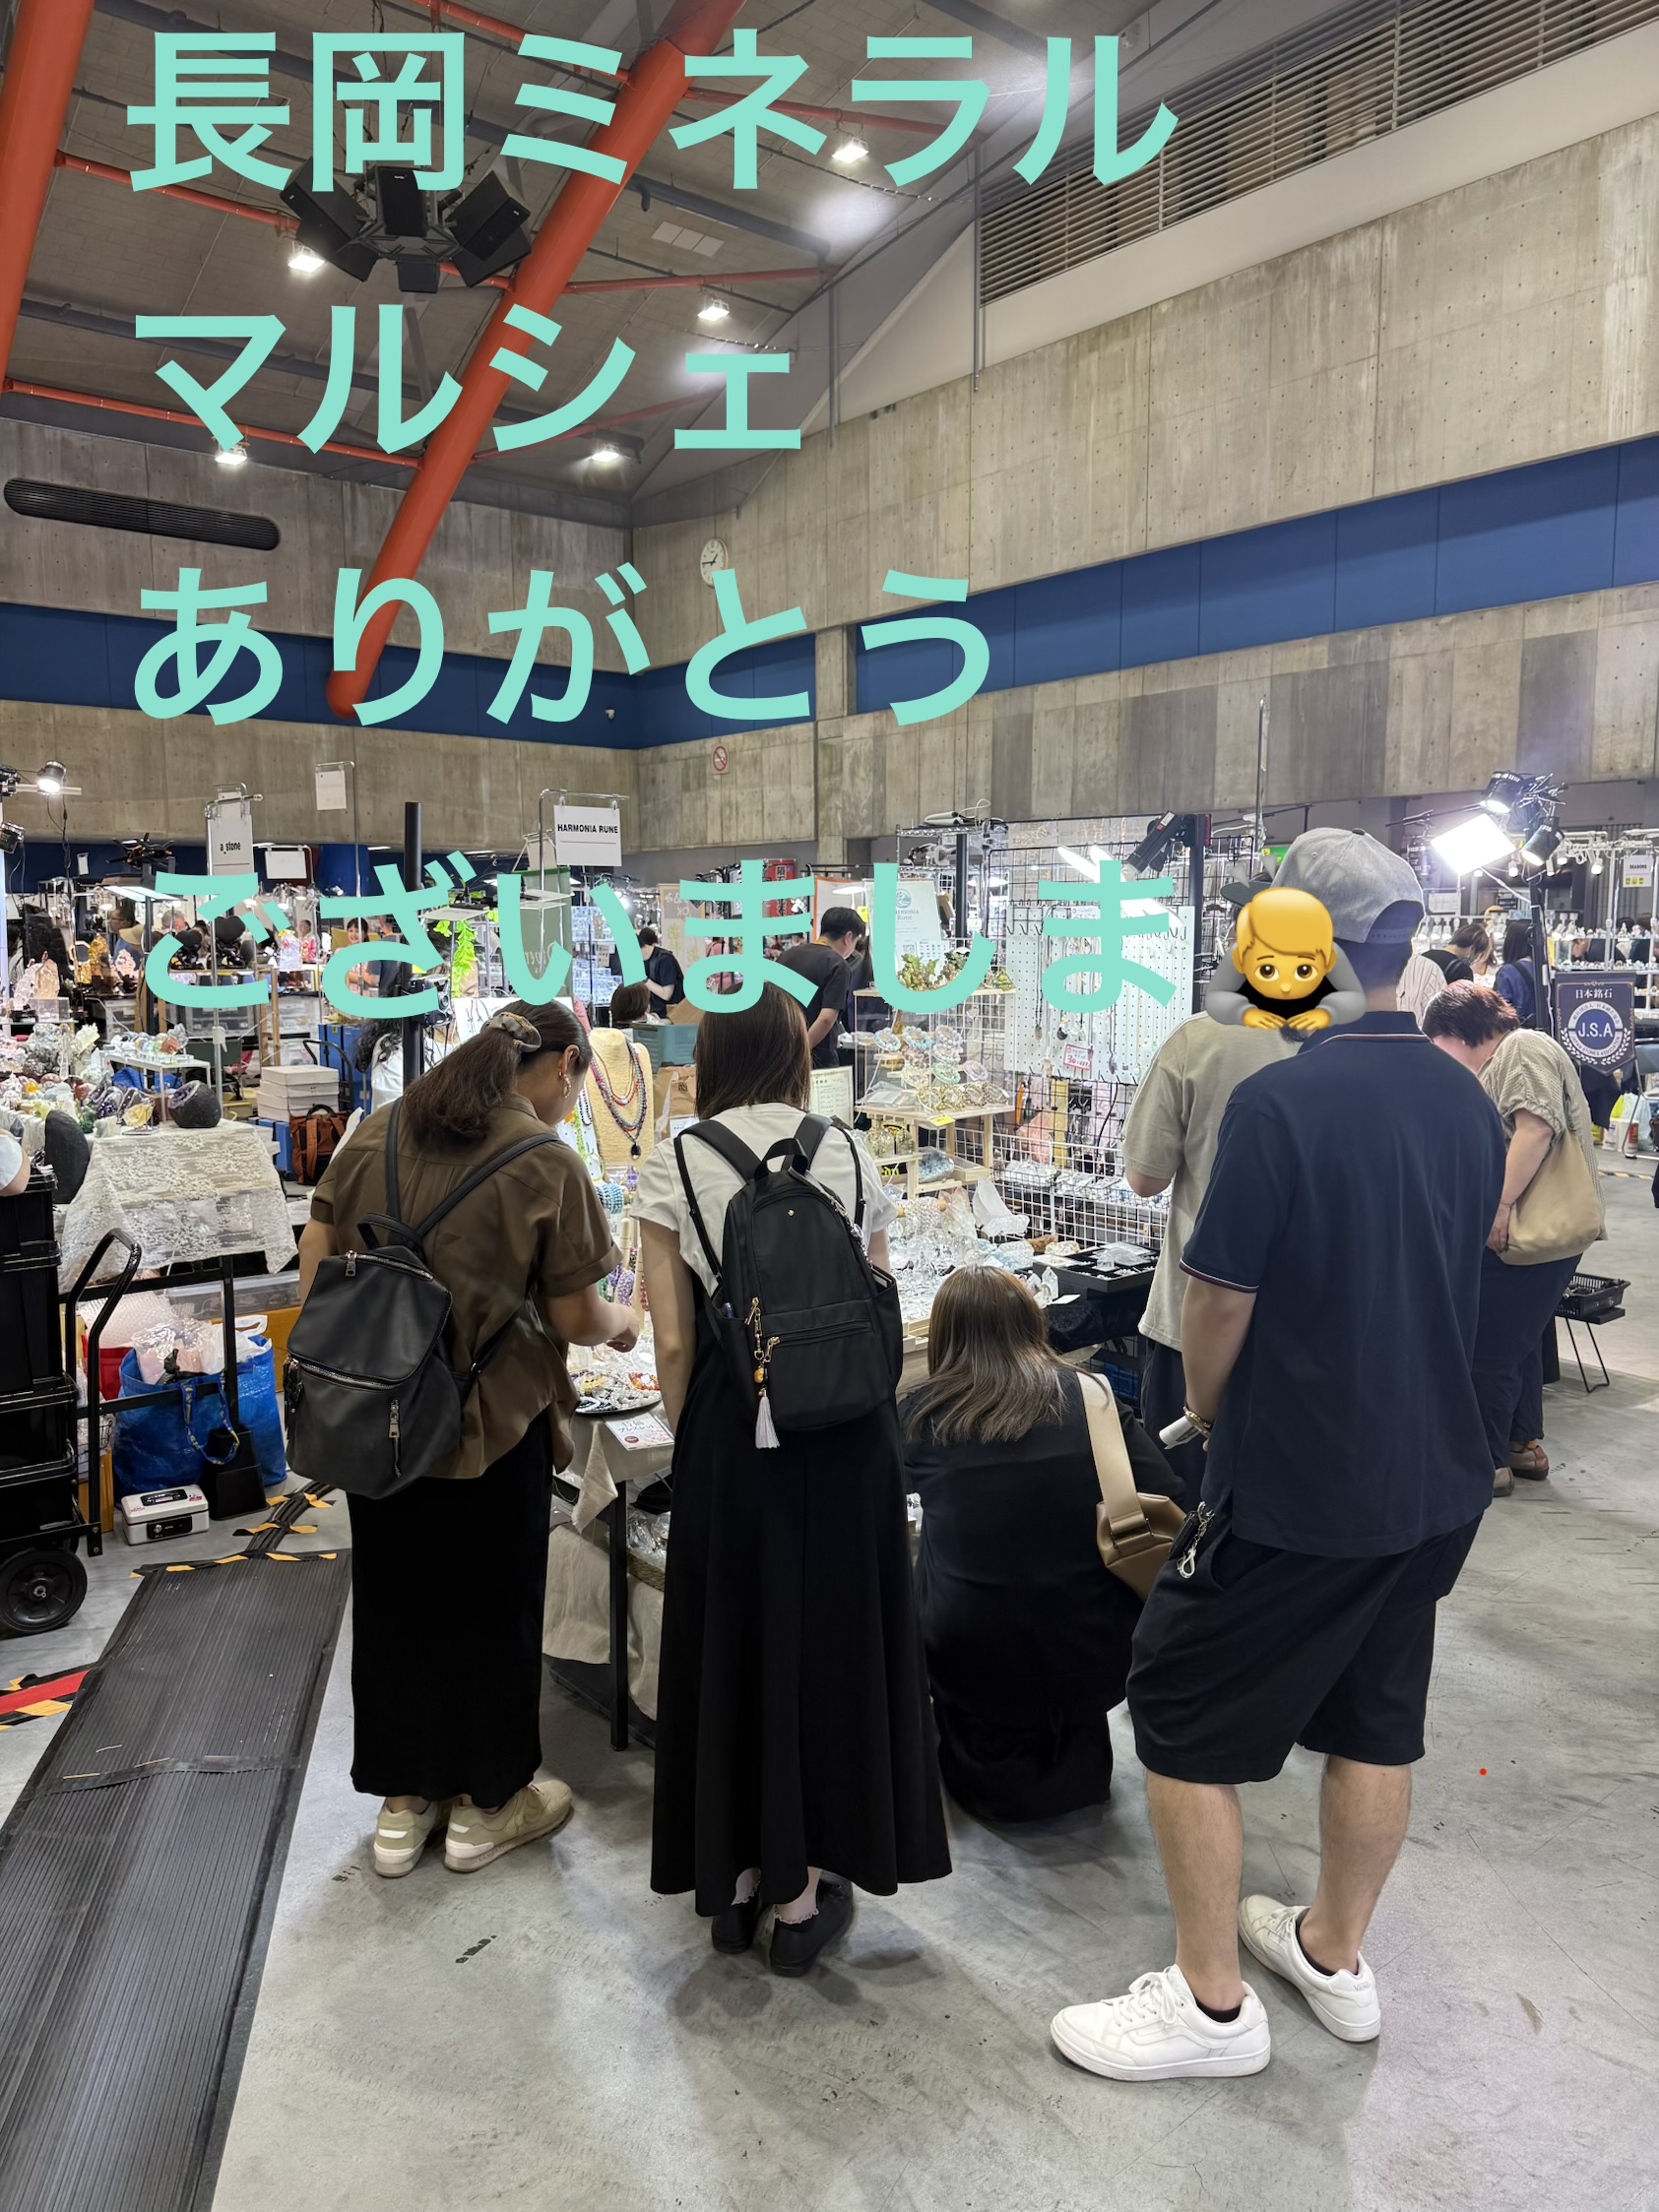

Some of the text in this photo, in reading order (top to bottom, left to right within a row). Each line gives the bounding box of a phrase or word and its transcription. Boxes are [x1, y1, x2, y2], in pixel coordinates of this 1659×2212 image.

[557, 823, 618, 834] HARMONIA RUNE
[1577, 1022, 1613, 1038] J.S.A
